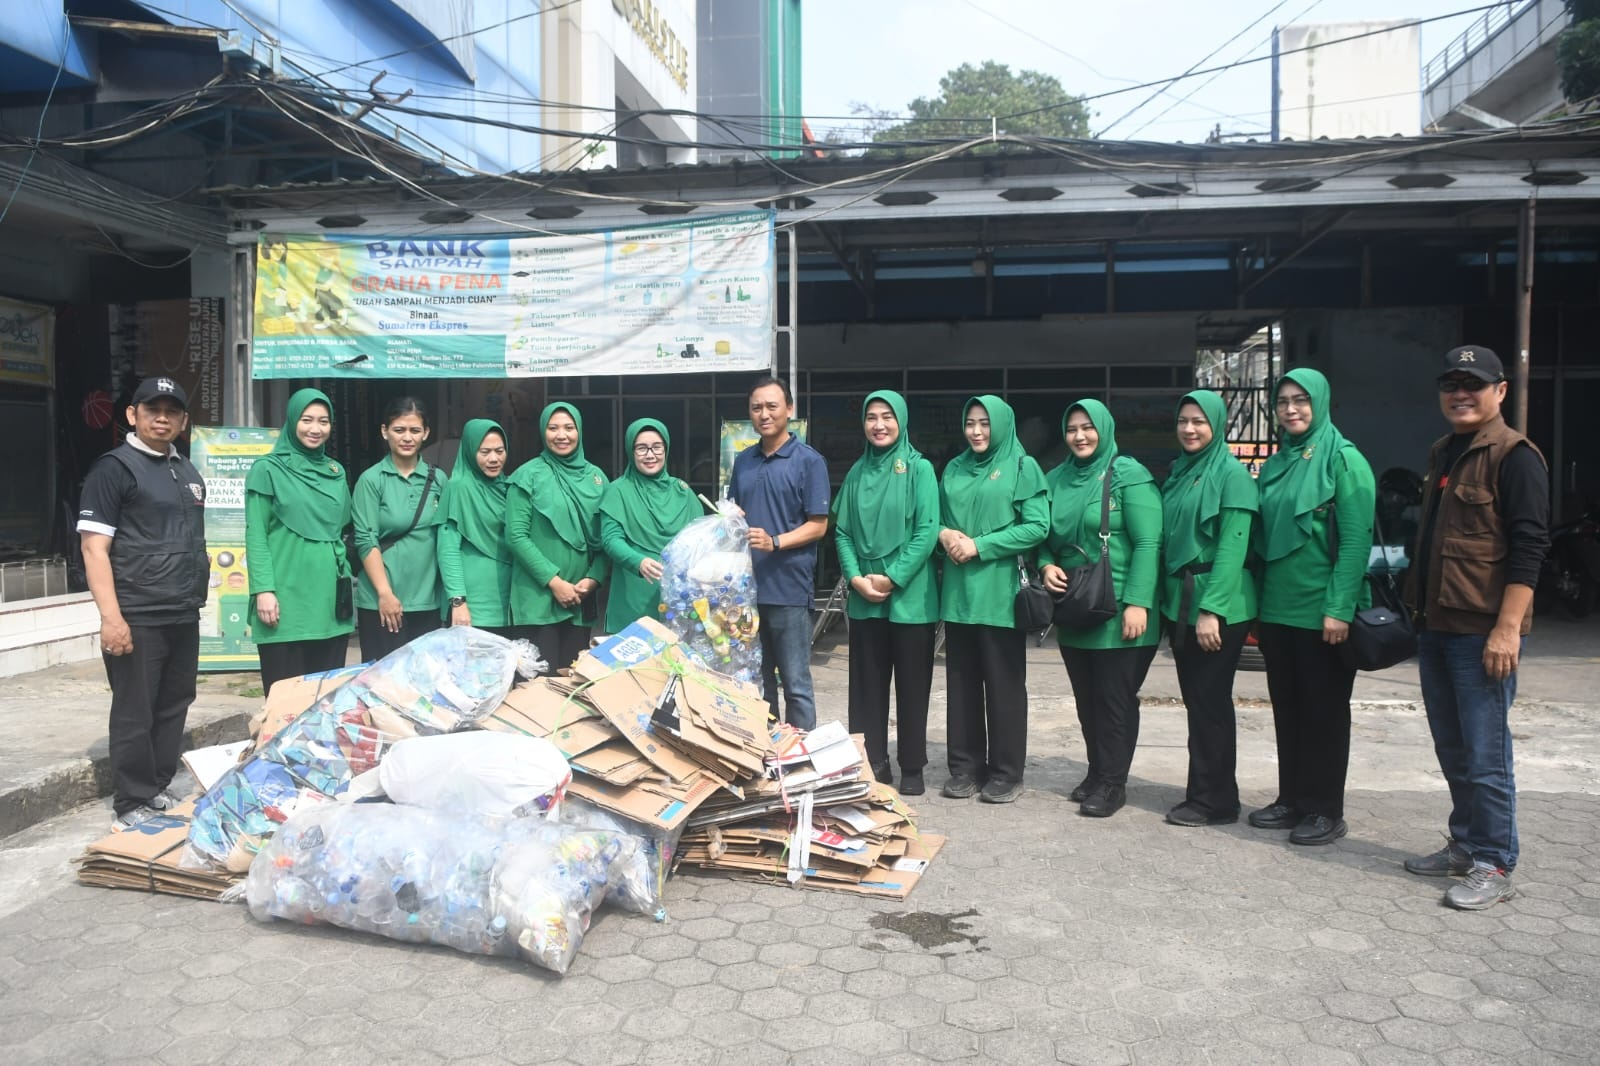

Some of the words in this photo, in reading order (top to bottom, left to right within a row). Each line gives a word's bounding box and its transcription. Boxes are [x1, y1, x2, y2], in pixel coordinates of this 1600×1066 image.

[366, 240, 488, 259] BANK
[379, 256, 483, 270] SAMPAH
[351, 275, 430, 293] GRAHA
[439, 274, 502, 290] PENA
[384, 296, 422, 305] SAMPAH
[424, 296, 466, 305] MENJADI
[467, 295, 497, 304] CUAN"
[410, 310, 439, 319] Binaan
[378, 320, 426, 330] Sumatera
[428, 321, 469, 331] Ekspres
[201, 322, 209, 372] SUMATRA
[201, 374, 209, 409] SOUTH
[210, 361, 219, 422] BASKETBALL
[206, 479, 227, 487] AYO
[209, 488, 236, 496] BANK
[206, 497, 241, 505] GRAHA
[616, 640, 644, 659] AQUA
